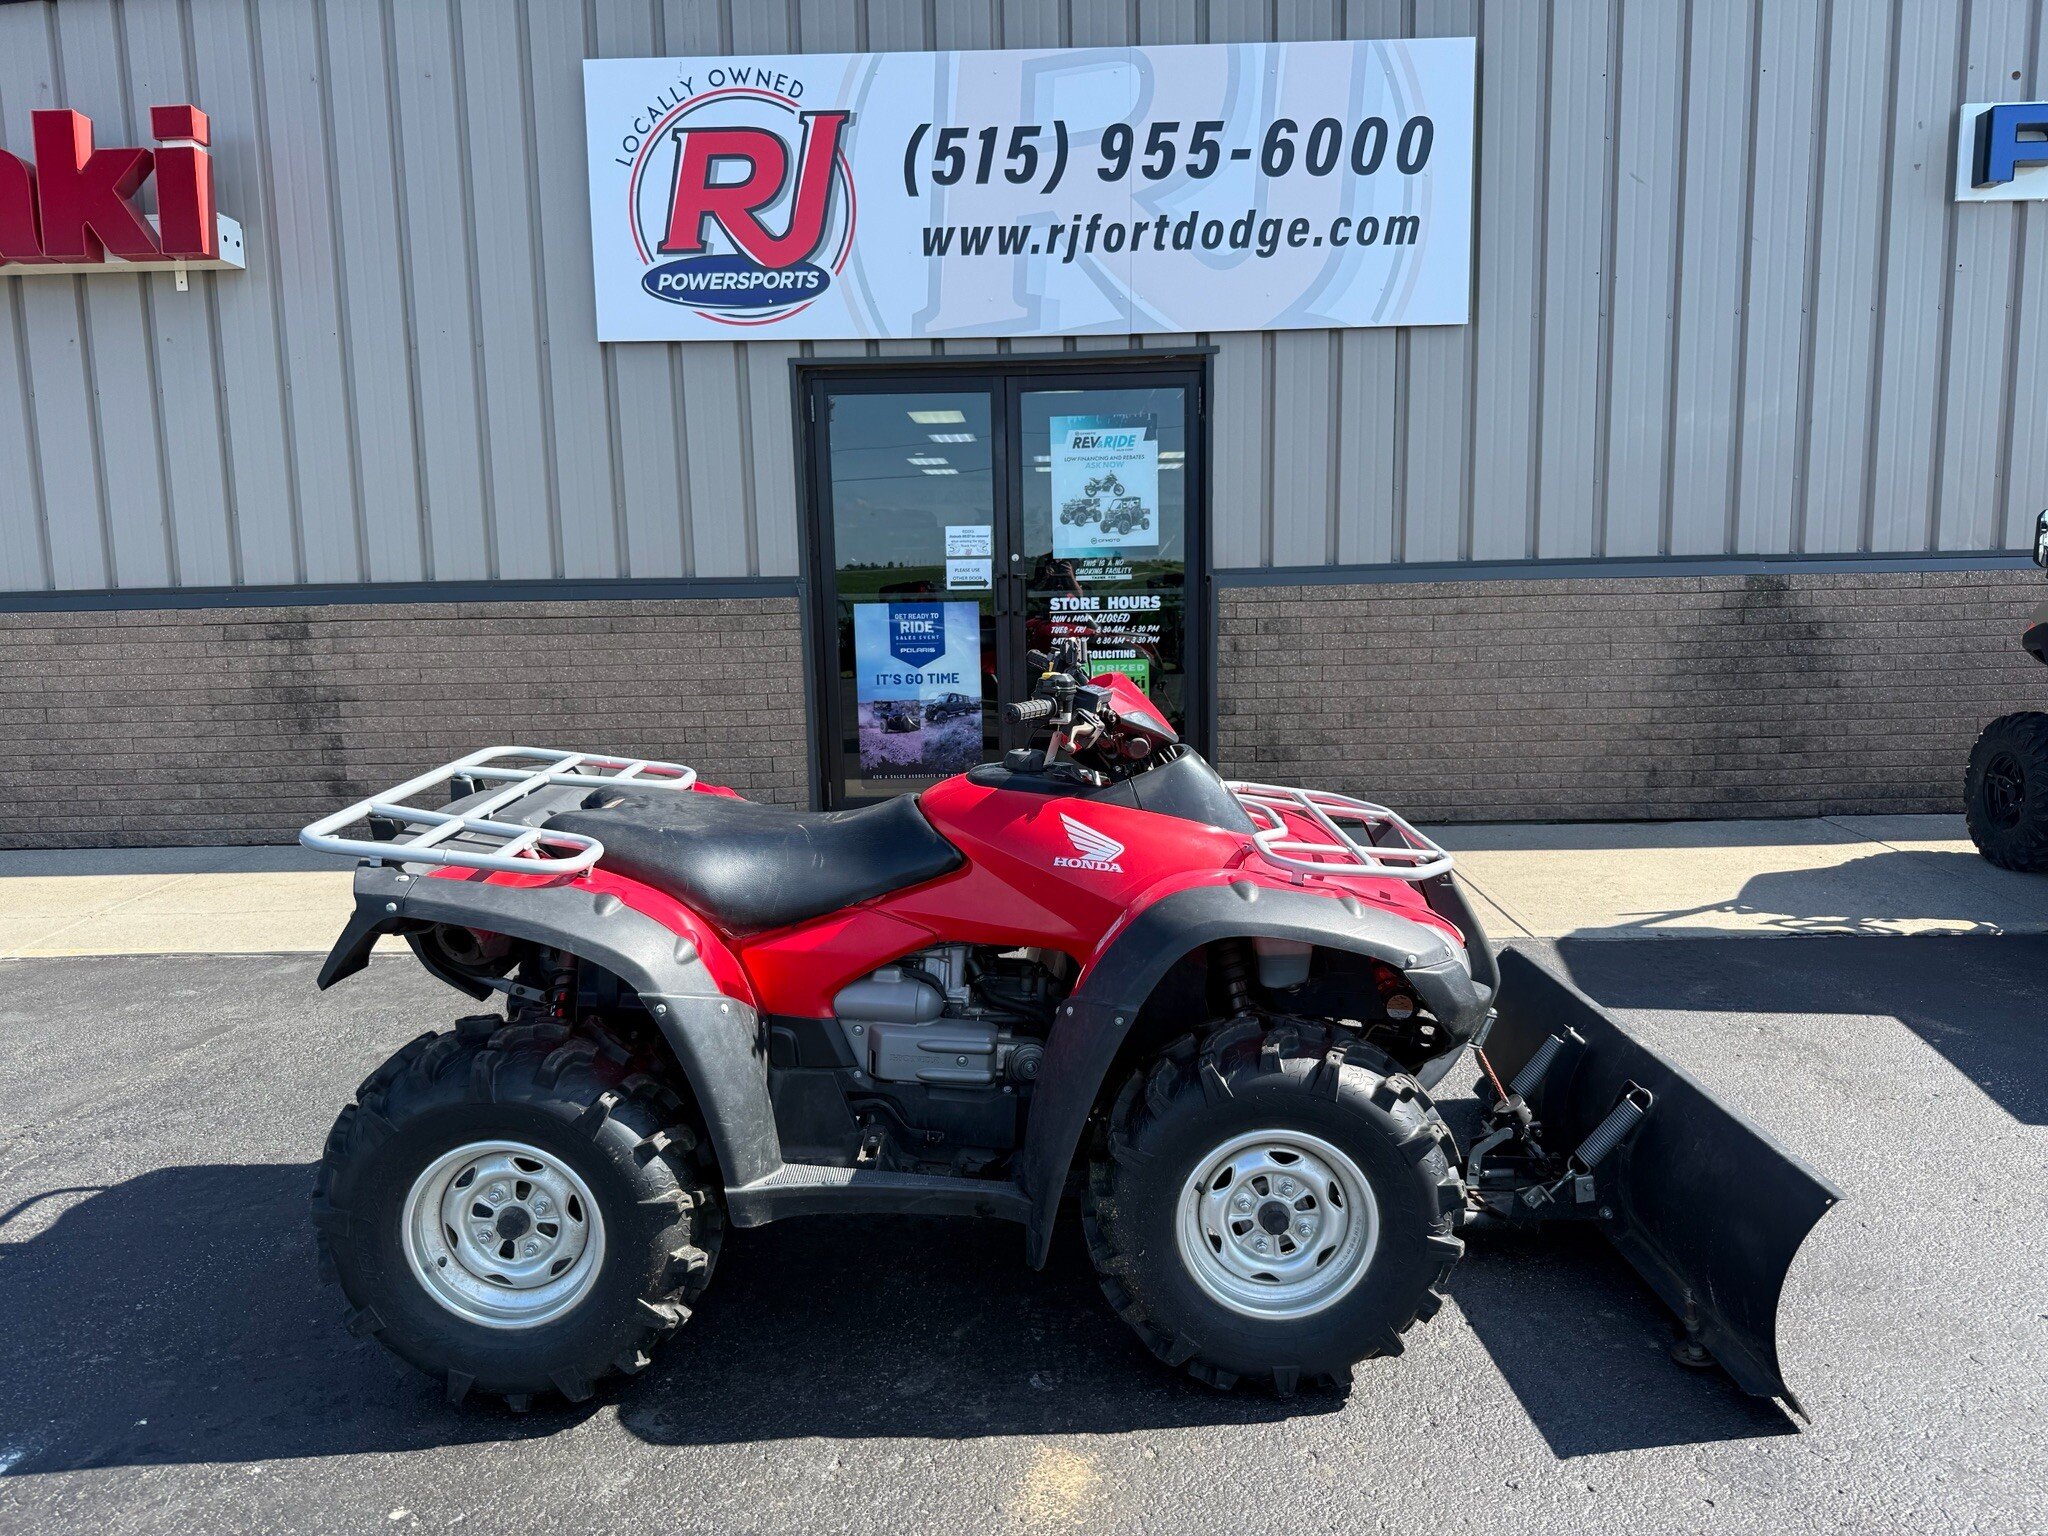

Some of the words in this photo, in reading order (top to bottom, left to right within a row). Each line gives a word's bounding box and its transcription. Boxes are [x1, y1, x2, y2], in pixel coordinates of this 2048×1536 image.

[615, 76, 694, 168] LOCALLY
[708, 66, 804, 99] OWNED
[903, 120, 1069, 197] (515)
[1097, 115, 1435, 183] 955-6000
[656, 109, 855, 270] RJ
[921, 208, 1422, 264] www.rjfortdodge.com
[657, 270, 820, 292] POWERSPORTS
[1105, 566, 1132, 574] FACILITY
[1050, 596, 1100, 611] STORE
[1108, 595, 1161, 610] HOURS
[1051, 614, 1067, 623] SUN
[1072, 614, 1088, 622] MON
[1096, 613, 1130, 623] CLOSED
[900, 620, 935, 634] RIDE
[1051, 626, 1068, 634] TUES
[1147, 624, 1160, 633] PM
[1147, 635, 1160, 643] PM
[876, 674, 902, 685] IT'S
[905, 673, 924, 685] GO
[927, 672, 960, 684] TIME
[1053, 857, 1124, 874] HONDA
